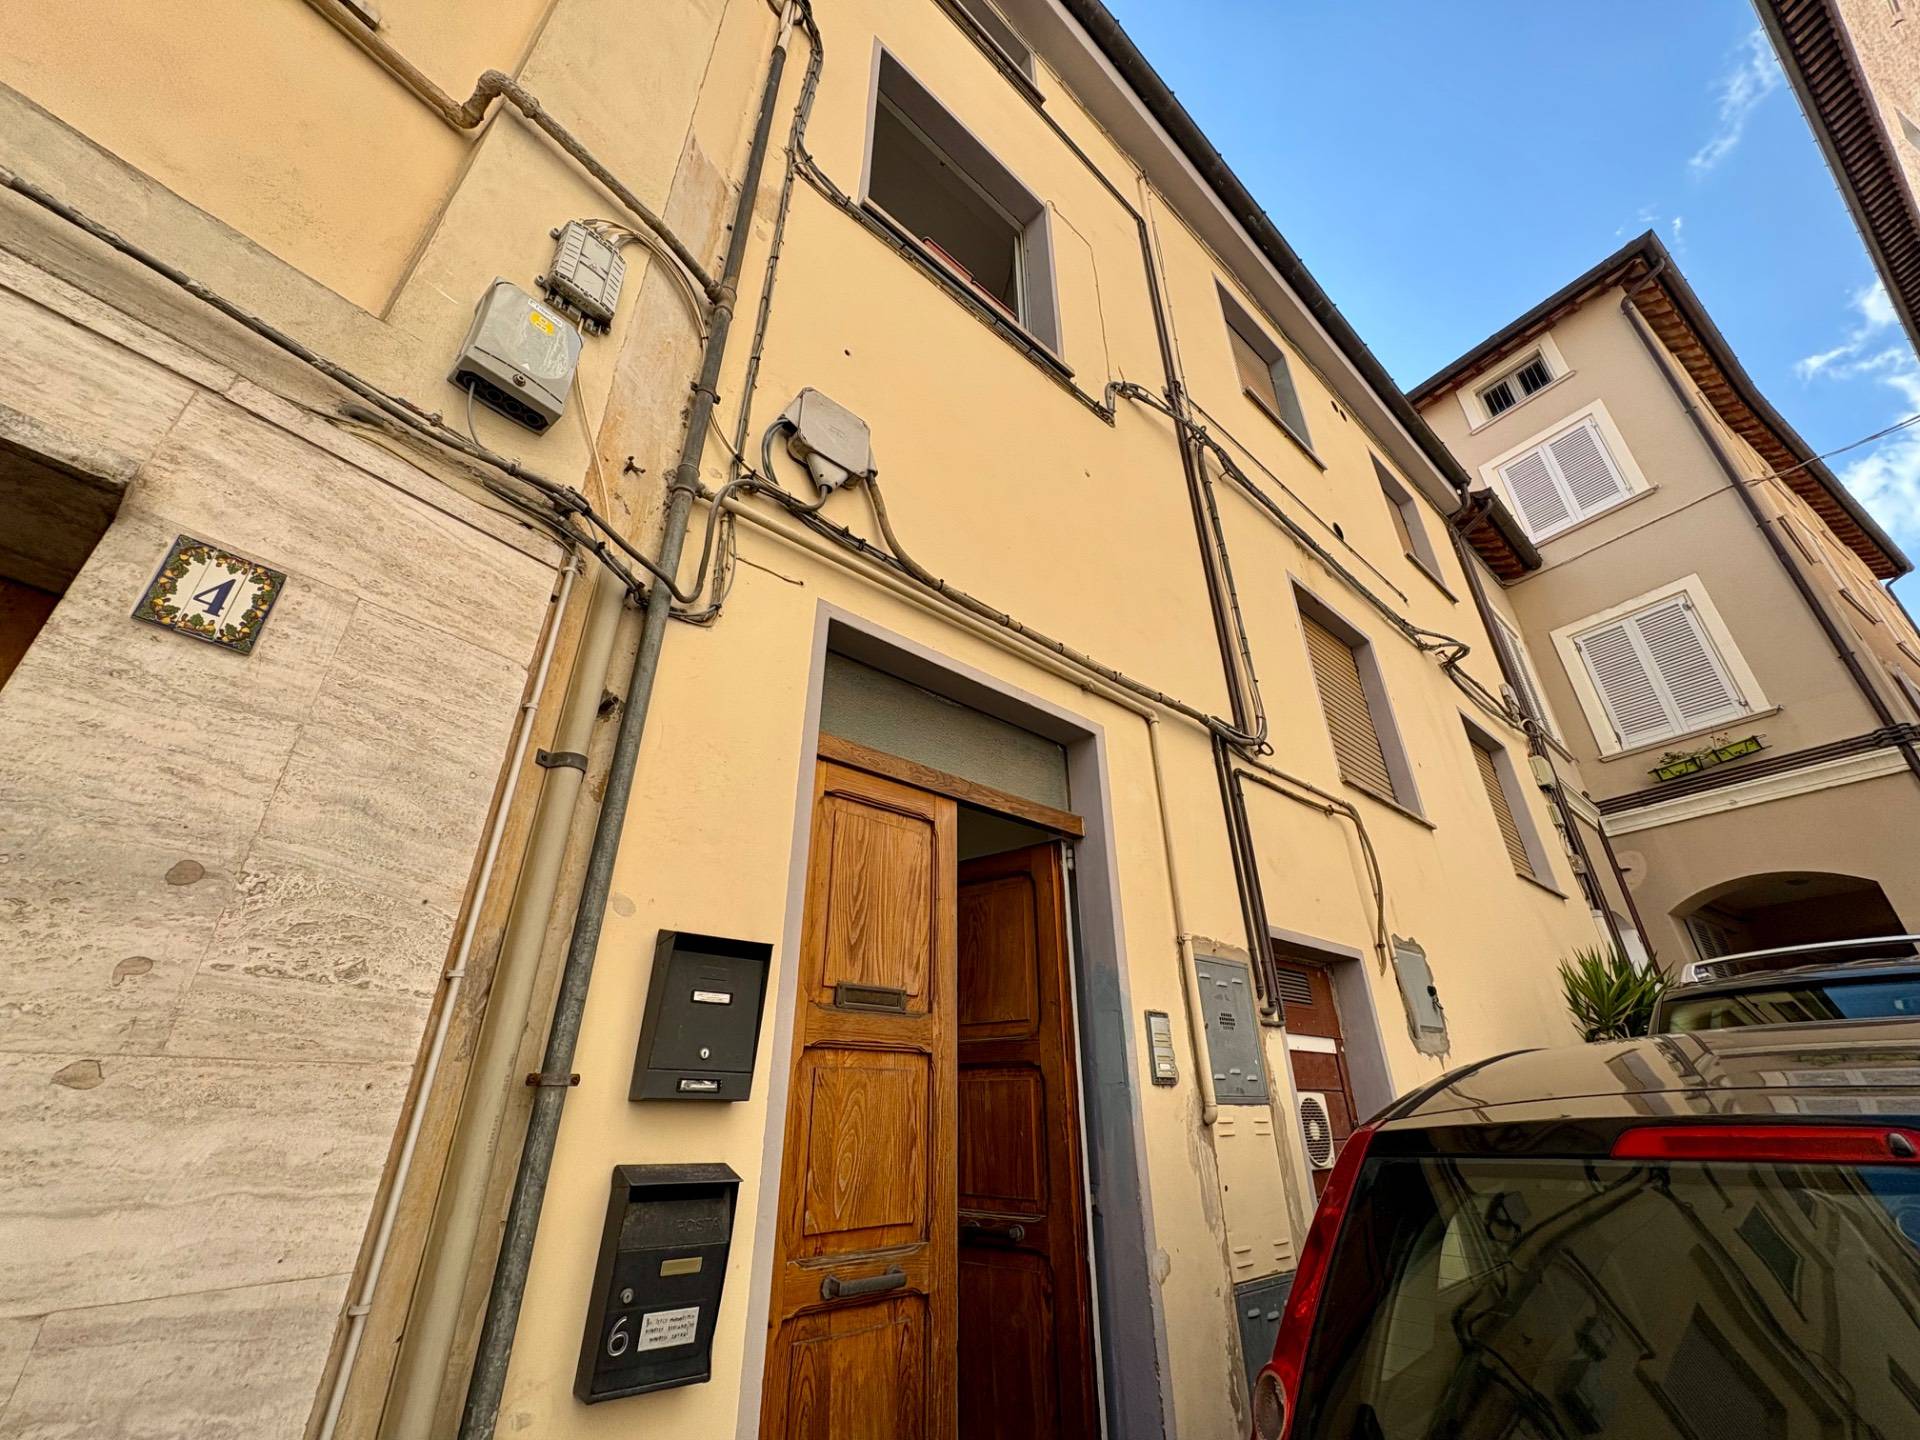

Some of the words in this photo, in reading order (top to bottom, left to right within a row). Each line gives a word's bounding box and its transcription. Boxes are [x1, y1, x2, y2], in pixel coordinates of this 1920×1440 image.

[193, 578, 237, 617] 4
[674, 1216, 720, 1232] POSTA
[607, 1315, 628, 1356] 6
